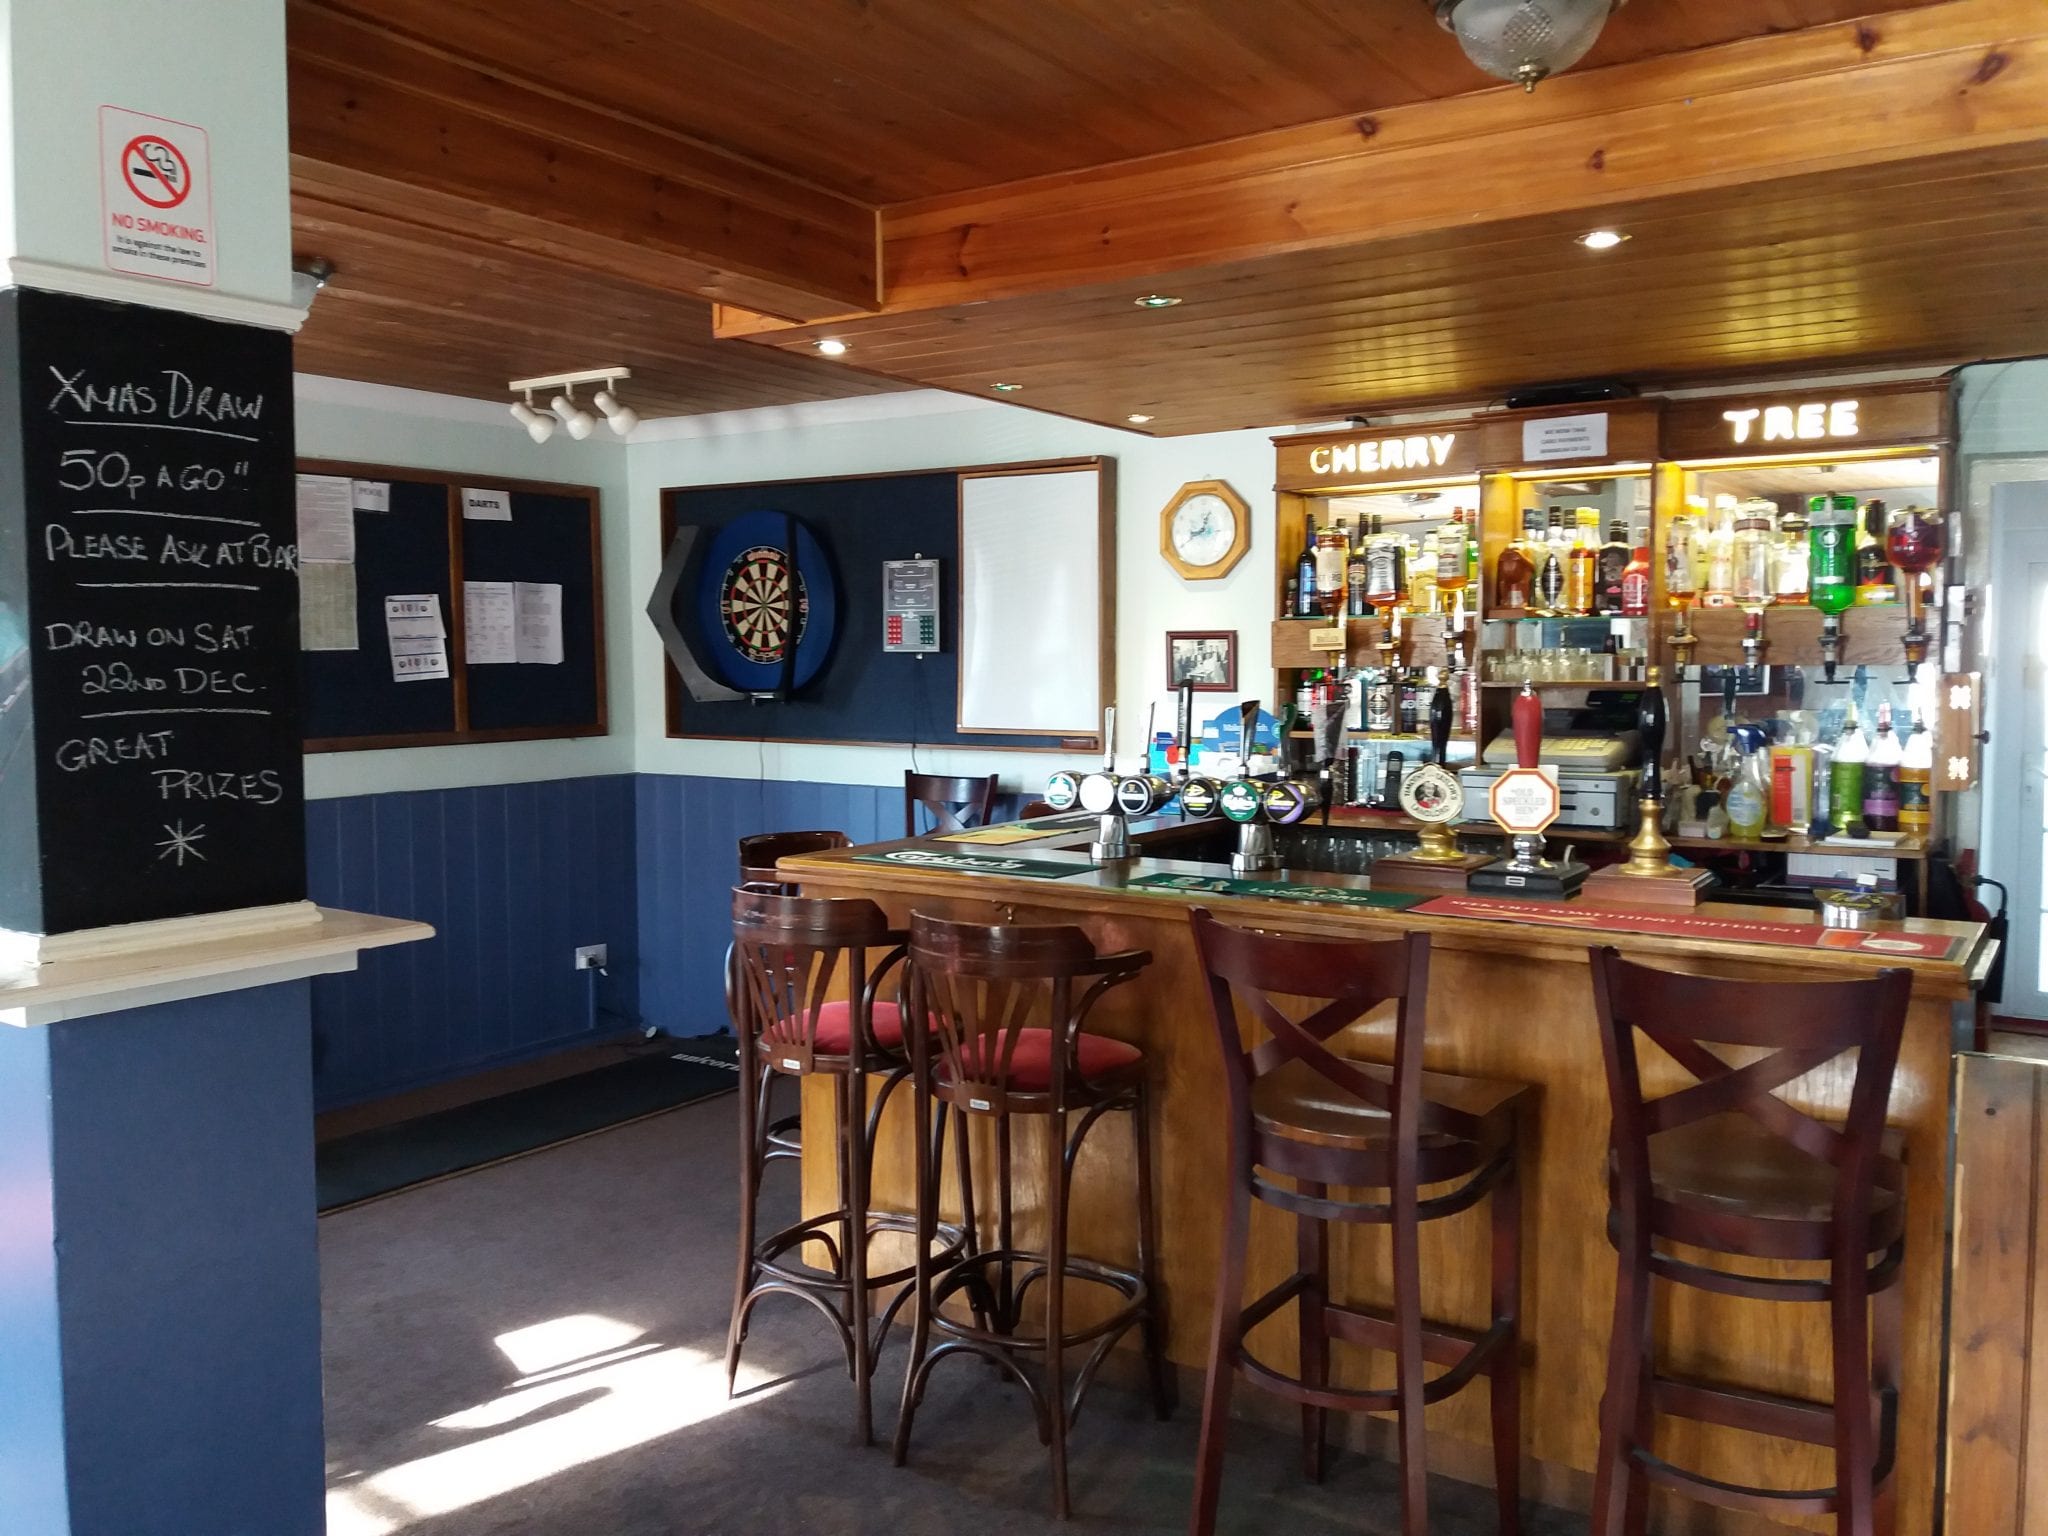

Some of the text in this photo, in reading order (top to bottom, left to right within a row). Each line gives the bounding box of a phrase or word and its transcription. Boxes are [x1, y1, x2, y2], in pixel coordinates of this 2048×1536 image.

[112, 212, 134, 229] NO
[162, 369, 263, 422] DRAW
[1722, 399, 1860, 444] TREE
[1308, 433, 1456, 475] CHERRY
[468, 498, 500, 509] DARTS
[45, 523, 149, 562] PLEASE
[159, 533, 212, 569] ASK
[215, 541, 247, 566] AT
[45, 620, 255, 654] DRAW ON SAT
[55, 730, 175, 772] GREAT
[150, 768, 283, 805] PRIZES
[884, 850, 1026, 870] Carlsberg
